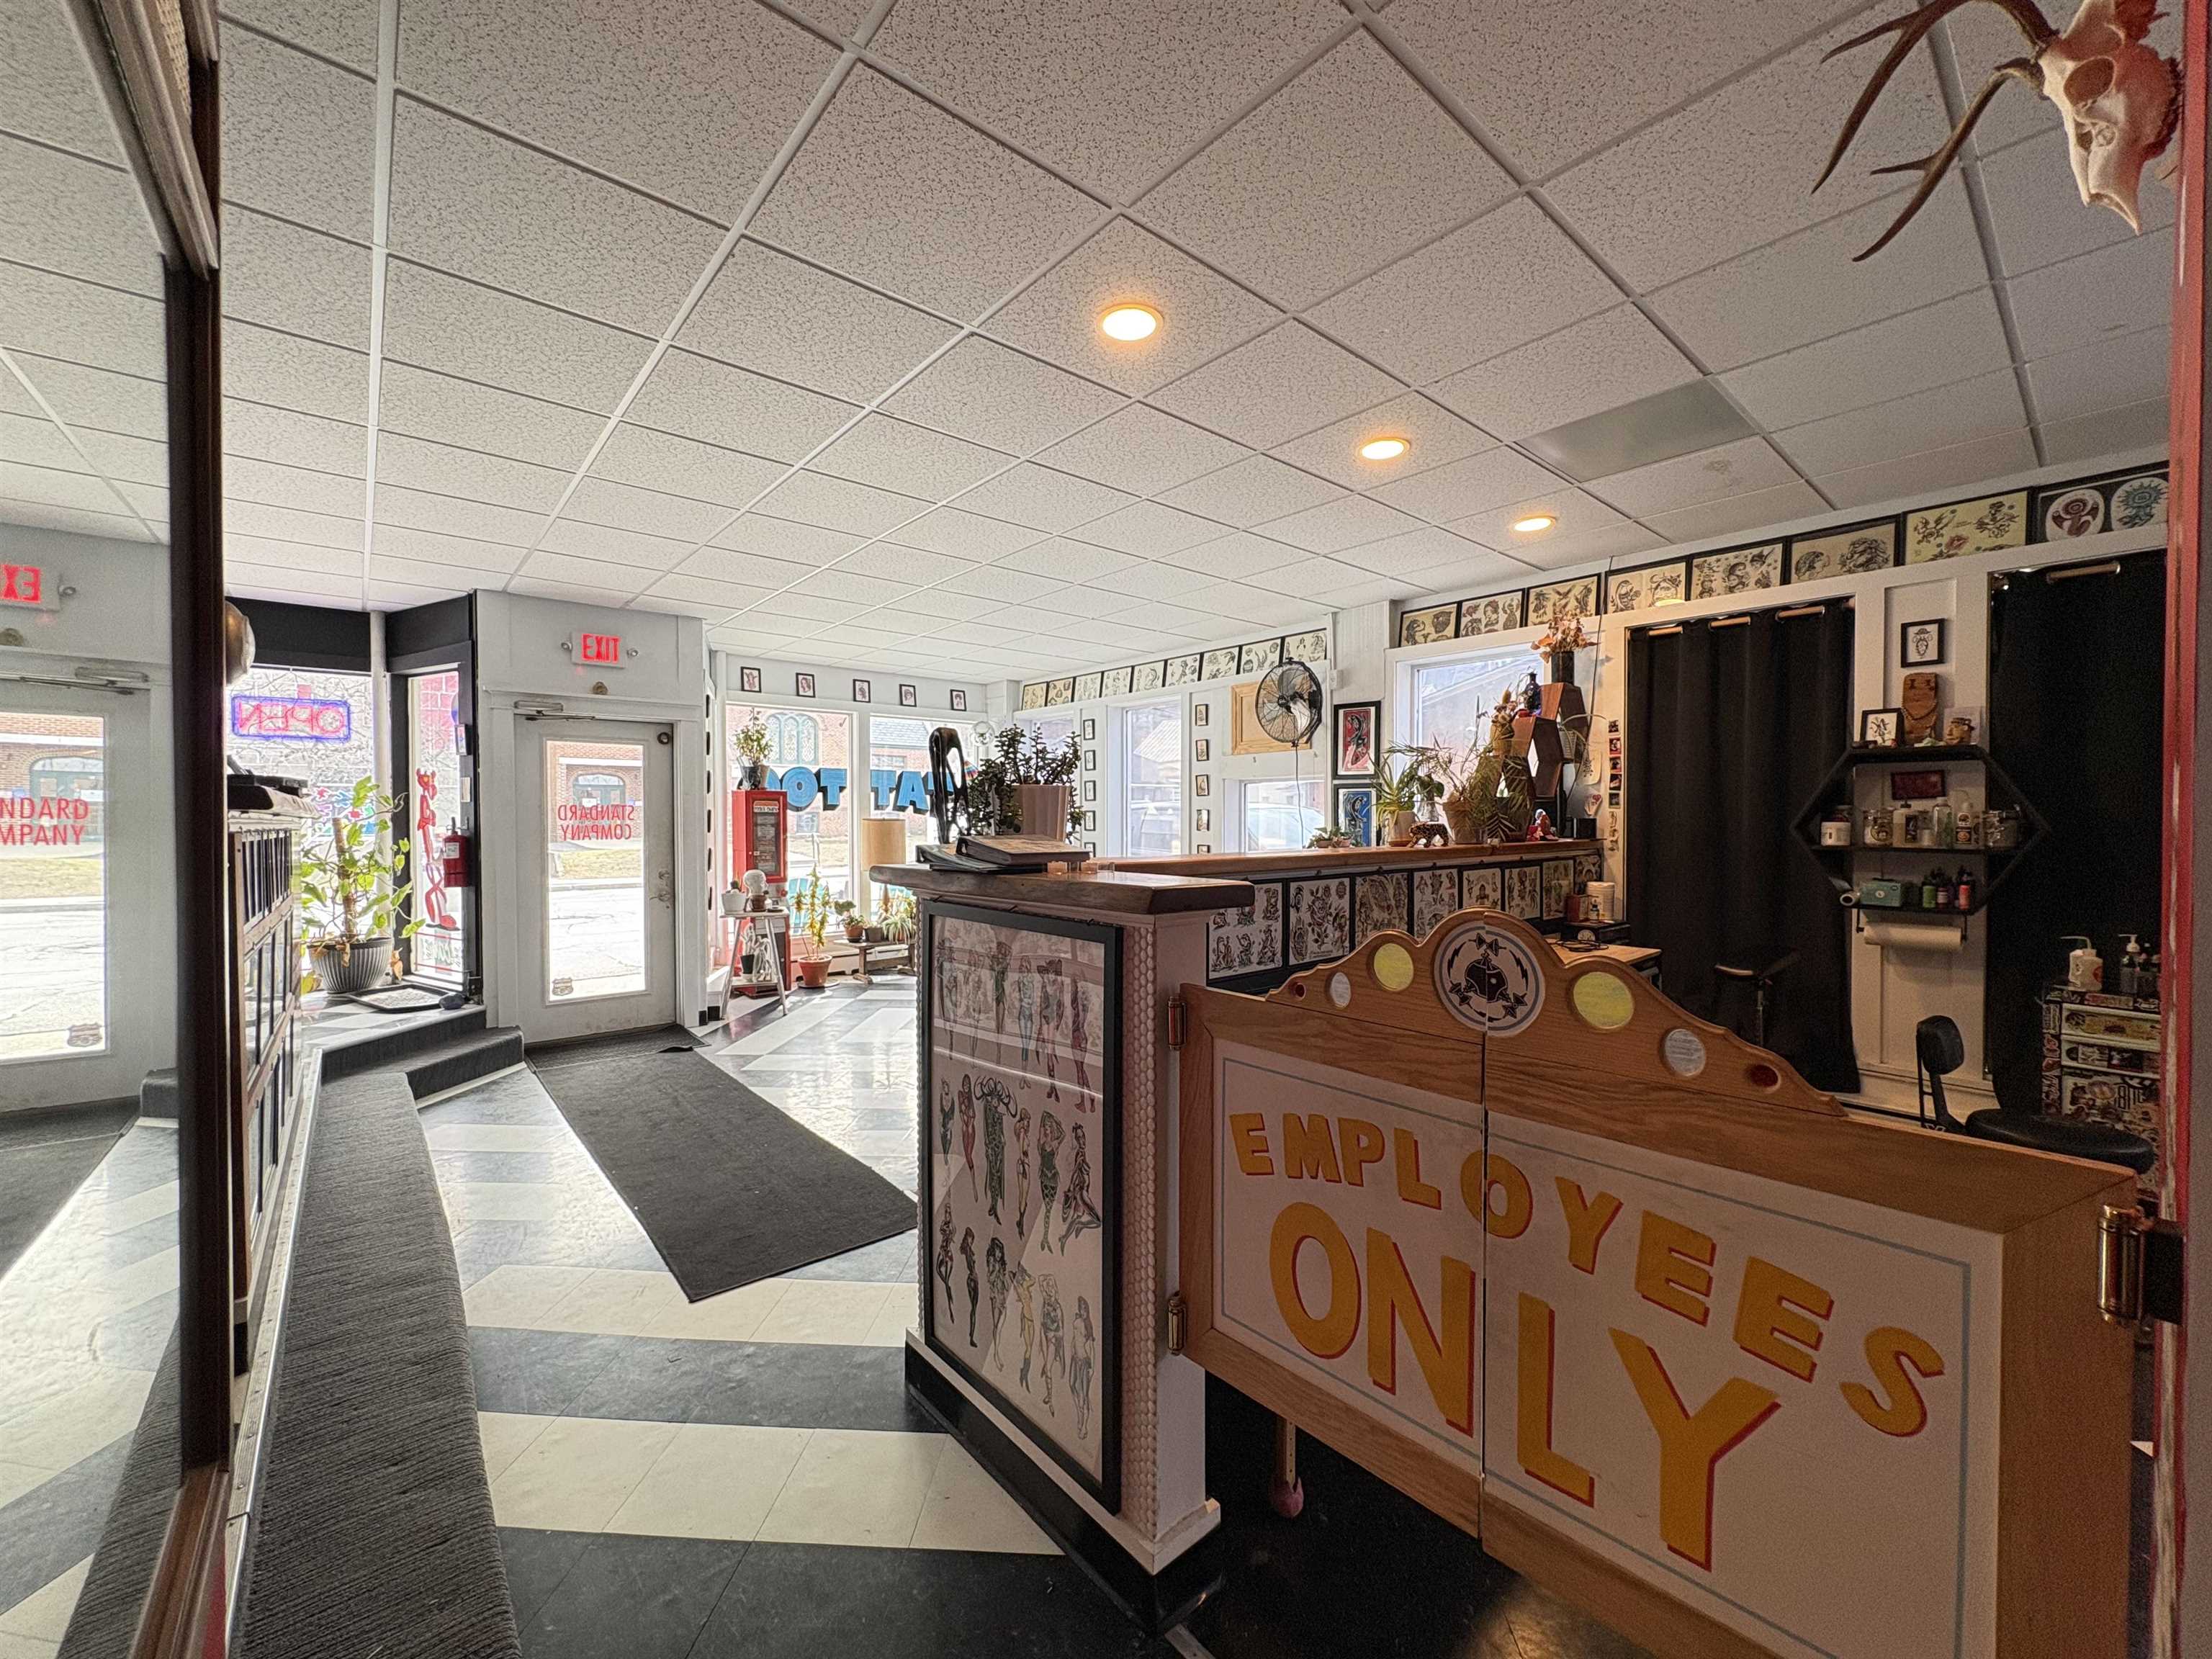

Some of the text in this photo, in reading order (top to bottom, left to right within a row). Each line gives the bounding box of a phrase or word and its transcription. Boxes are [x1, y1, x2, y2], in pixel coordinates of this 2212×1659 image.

[581, 633, 621, 664] EXIT
[0, 797, 89, 819] NDARD
[1228, 1112, 1945, 1437] EMPLOYEES
[1269, 1201, 1781, 1571] ONLY
